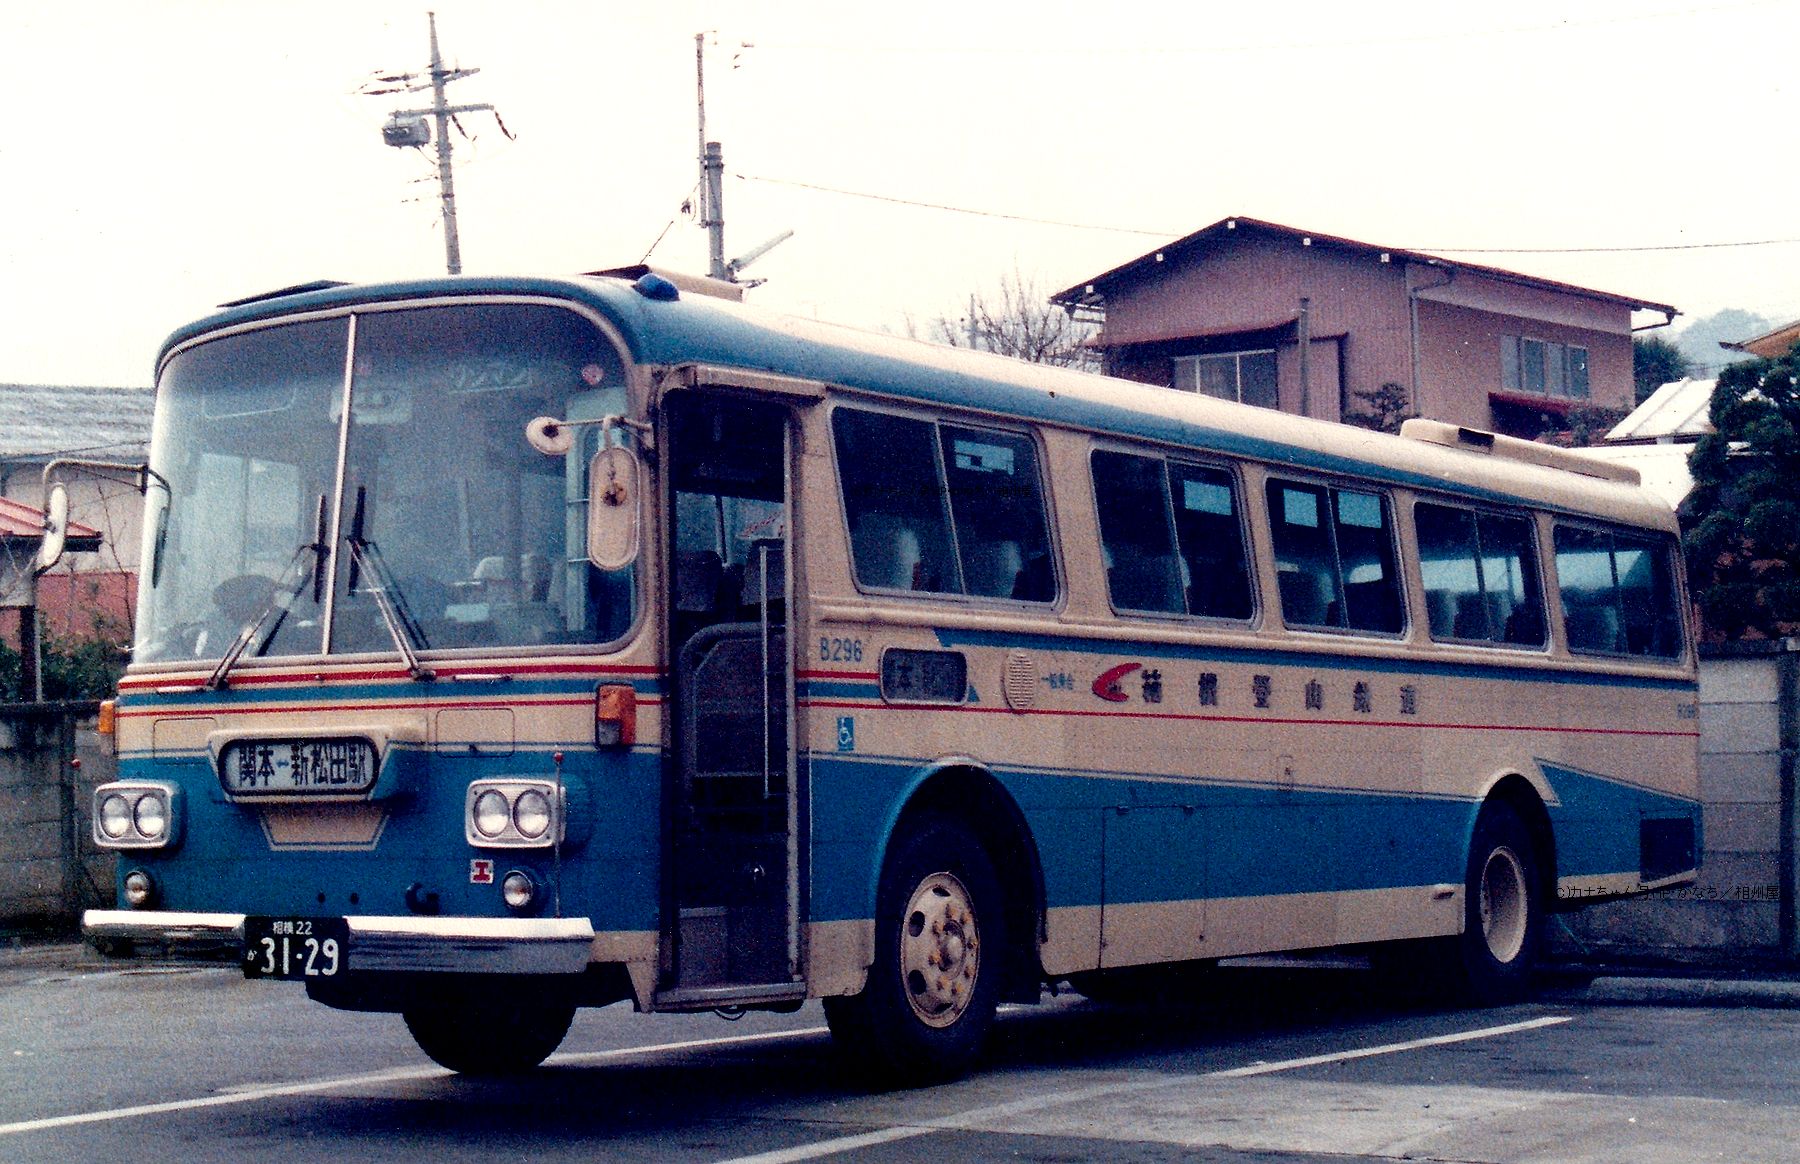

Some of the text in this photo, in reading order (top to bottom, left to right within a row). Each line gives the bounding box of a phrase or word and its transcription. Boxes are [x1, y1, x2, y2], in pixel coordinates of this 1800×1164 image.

[819, 637, 863, 662] B296
[272, 920, 313, 935] 相模 22
